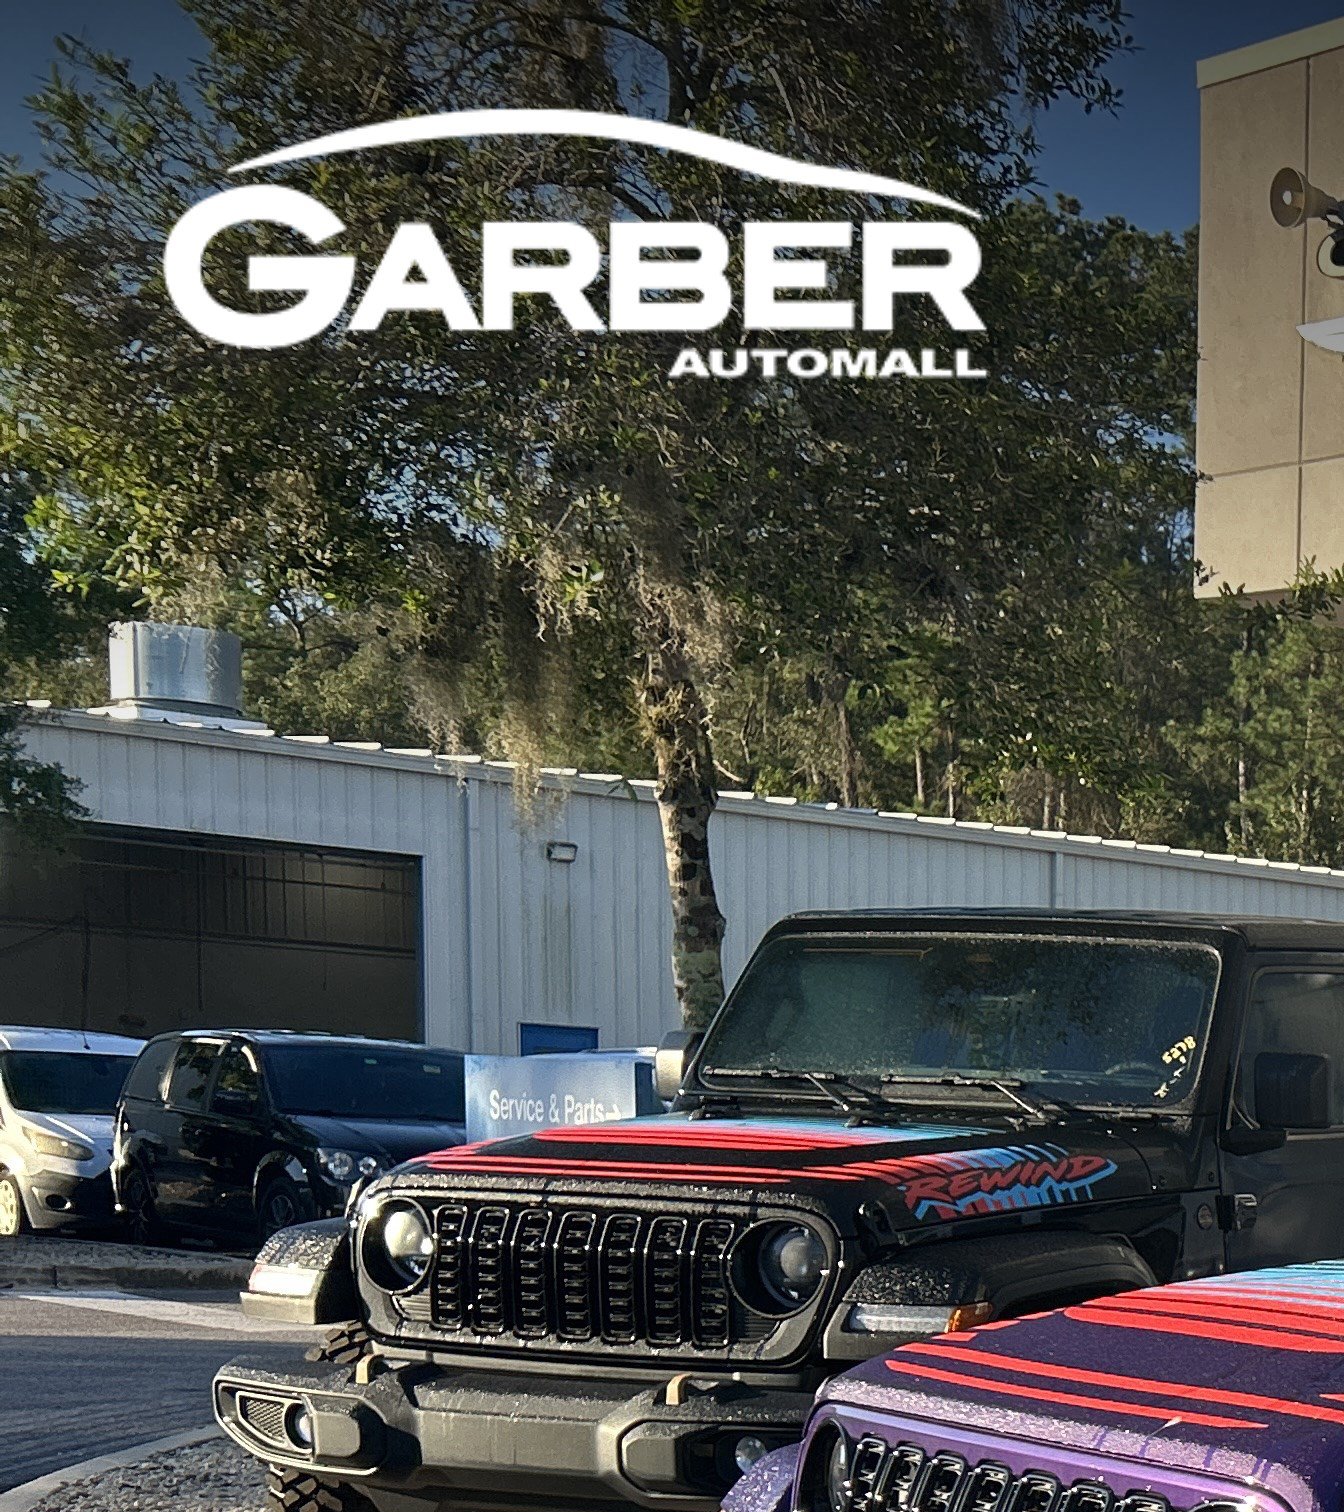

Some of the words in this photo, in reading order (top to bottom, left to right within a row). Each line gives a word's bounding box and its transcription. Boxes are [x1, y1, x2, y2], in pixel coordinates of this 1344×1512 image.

[489, 1089, 545, 1122] Service
[550, 1093, 560, 1123] &
[564, 1094, 605, 1125] Parts
[904, 1154, 1108, 1210] REWIND
